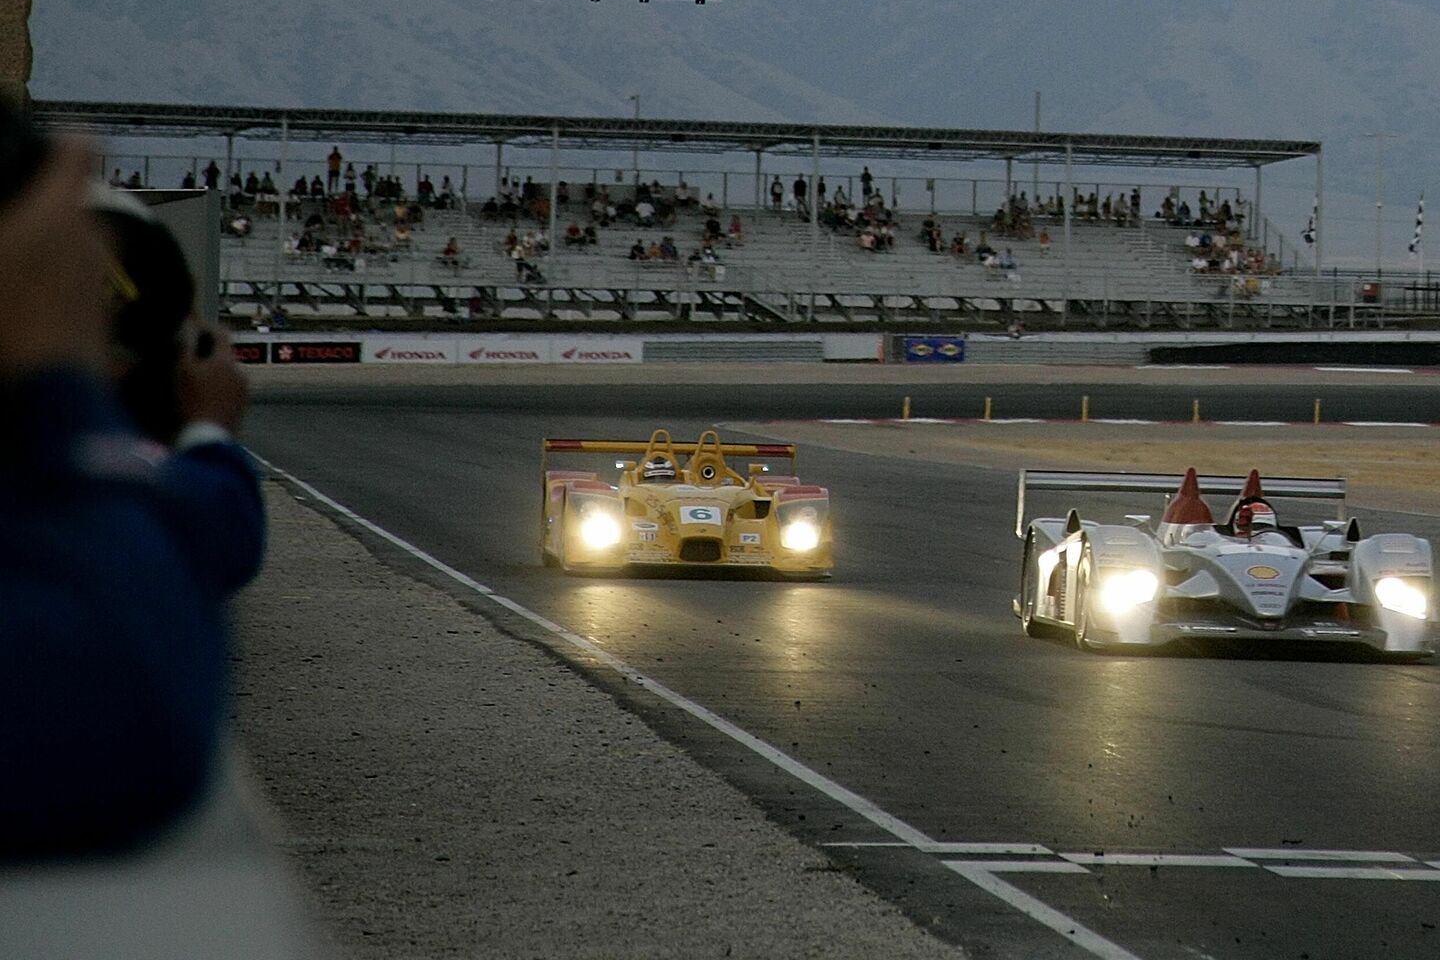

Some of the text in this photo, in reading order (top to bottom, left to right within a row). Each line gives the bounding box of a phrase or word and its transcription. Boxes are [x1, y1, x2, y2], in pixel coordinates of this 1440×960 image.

[298, 347, 354, 359] TEXACO
[391, 351, 447, 360] HONDA
[486, 351, 539, 360] HONDA
[578, 351, 633, 360] HONDA
[688, 508, 713, 521] 6
